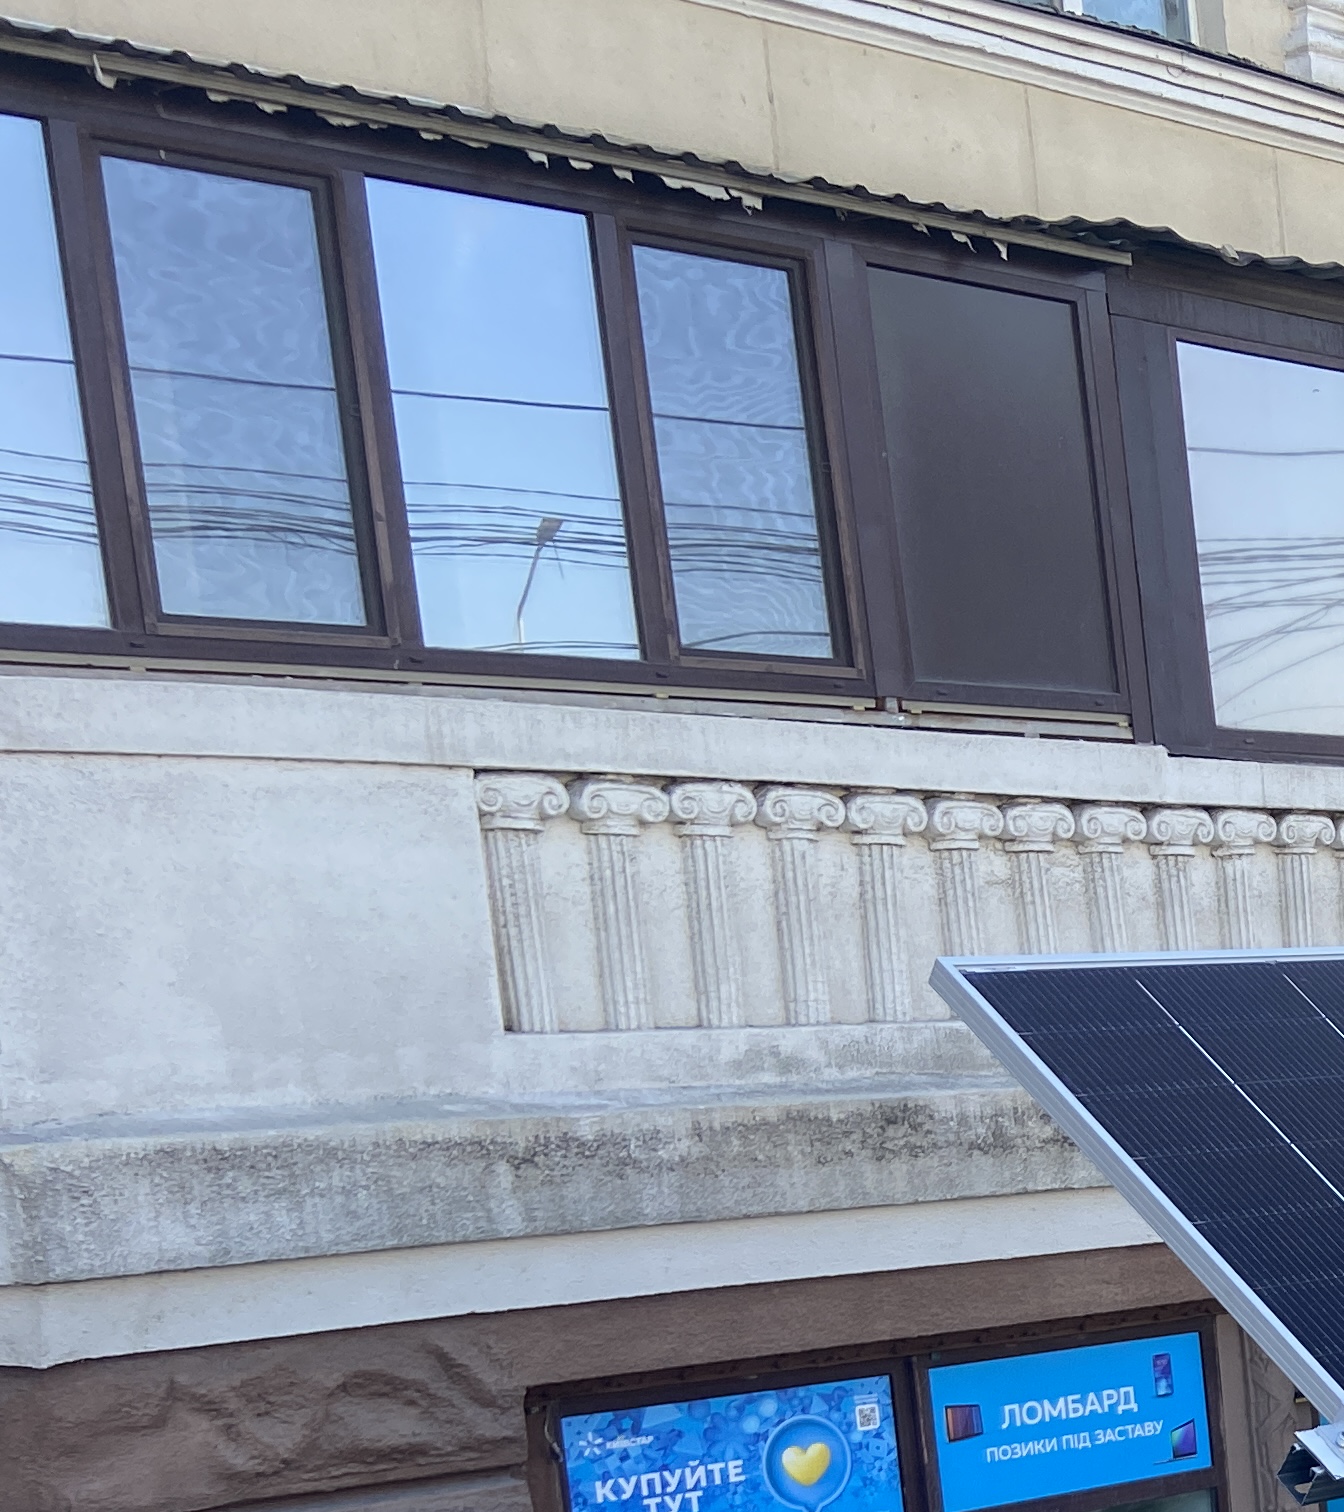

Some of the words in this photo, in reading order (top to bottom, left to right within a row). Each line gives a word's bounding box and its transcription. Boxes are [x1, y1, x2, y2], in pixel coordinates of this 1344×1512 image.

[1001, 1386, 1138, 1430] ЛОМБАРД
[986, 1436, 1059, 1464] ПОЗИКИ
[1061, 1433, 1092, 1451] ПІД
[1094, 1419, 1164, 1445] ЗАСТАВУ
[595, 1459, 747, 1504] КУПУЙТЕ
